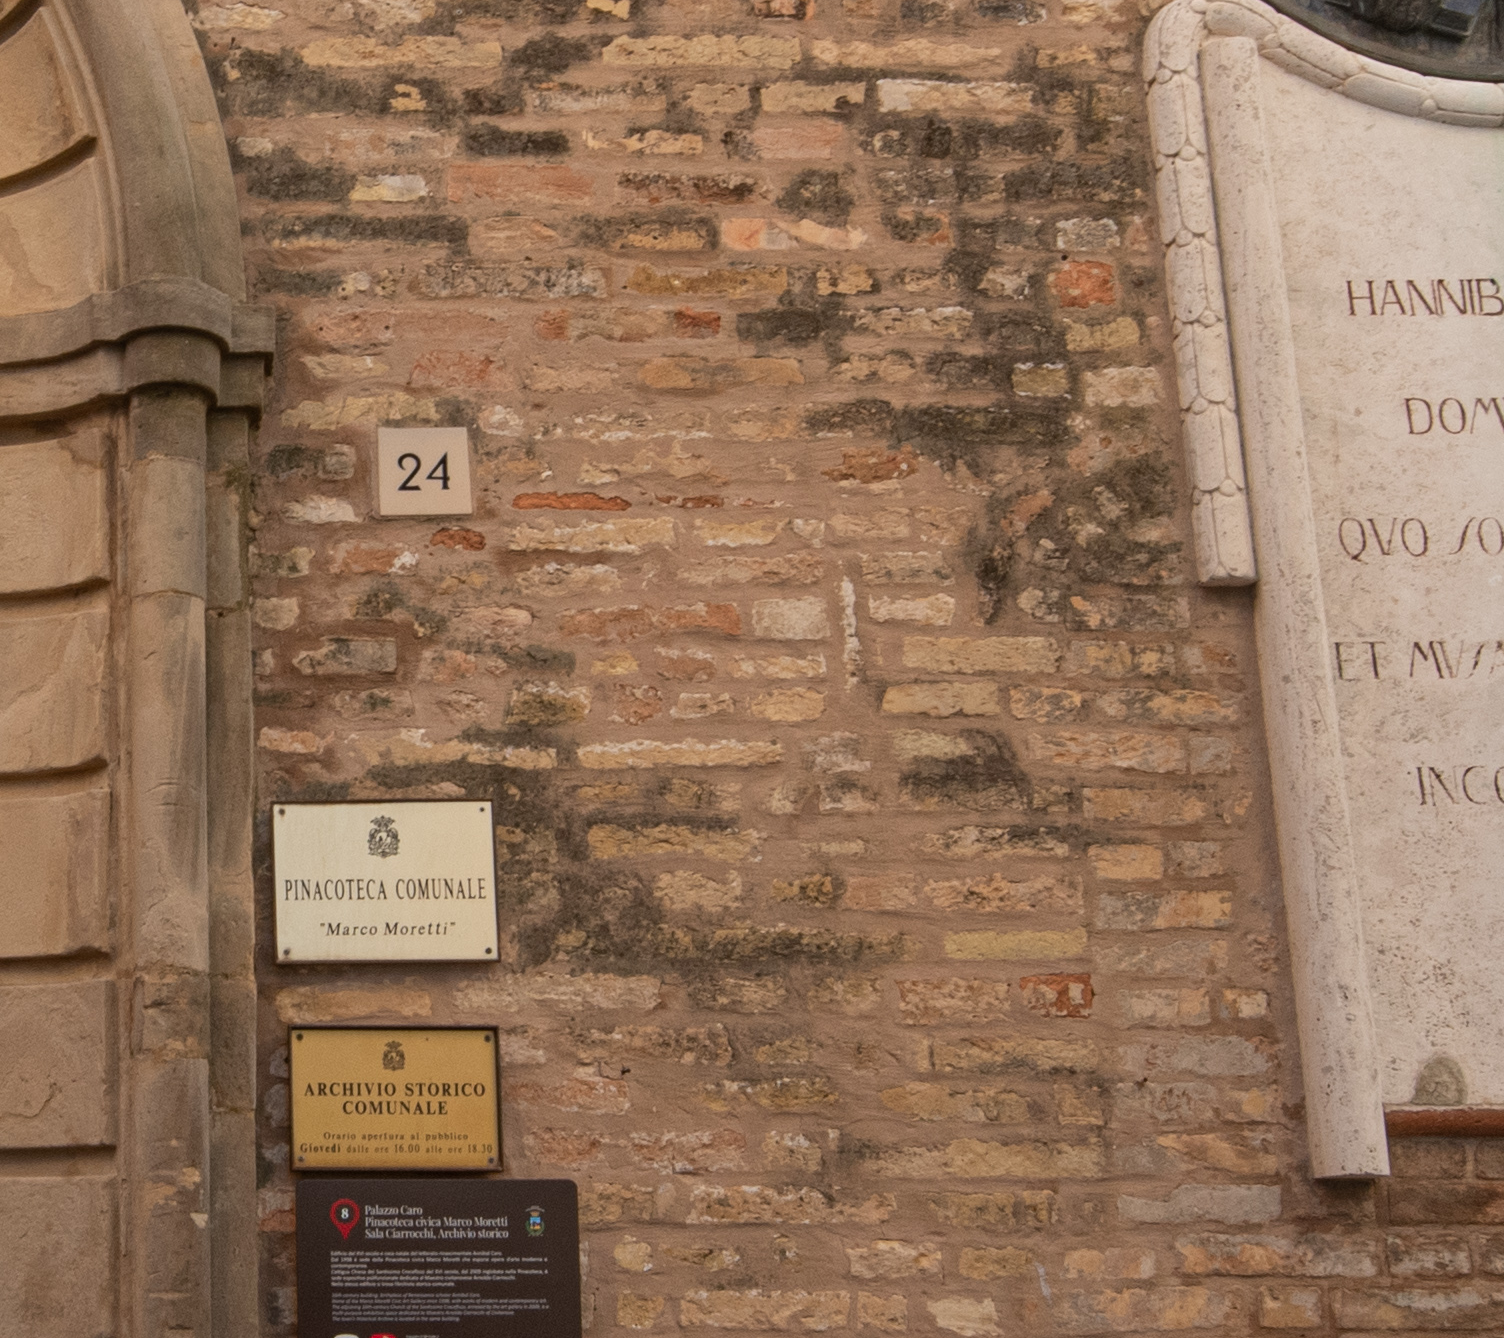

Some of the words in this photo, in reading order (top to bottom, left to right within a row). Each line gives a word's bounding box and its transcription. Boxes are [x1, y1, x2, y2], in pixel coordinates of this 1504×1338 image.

[397, 452, 451, 492] 24
[1338, 516, 1430, 562] QVO
[1333, 640, 1385, 681] ET
[284, 878, 388, 902] PINACOTECA
[395, 877, 488, 901] COMUNALE
[319, 922, 379, 938] "Marco
[383, 921, 456, 937] Moretti"
[304, 1081, 396, 1098] ARCHIVIO
[404, 1082, 486, 1098] STORICO
[342, 1100, 449, 1116] COMUNALE
[323, 1131, 357, 1140] Orario
[361, 1132, 405, 1142] apertura
[410, 1131, 420, 1140] al
[425, 1131, 469, 1142] pubblico
[394, 1143, 420, 1154] 16.00
[340, 1207, 349, 1220] 8
[364, 1205, 399, 1216] Palazzo
[400, 1205, 423, 1216] Caro
[365, 1216, 414, 1228] Pinacoteca
[415, 1216, 442, 1228] civica
[443, 1217, 473, 1228] Marco
[474, 1216, 508, 1228] Moretti
[365, 1228, 384, 1239] Sala
[439, 1228, 476, 1239] Archivio
[478, 1228, 509, 1239] storico
